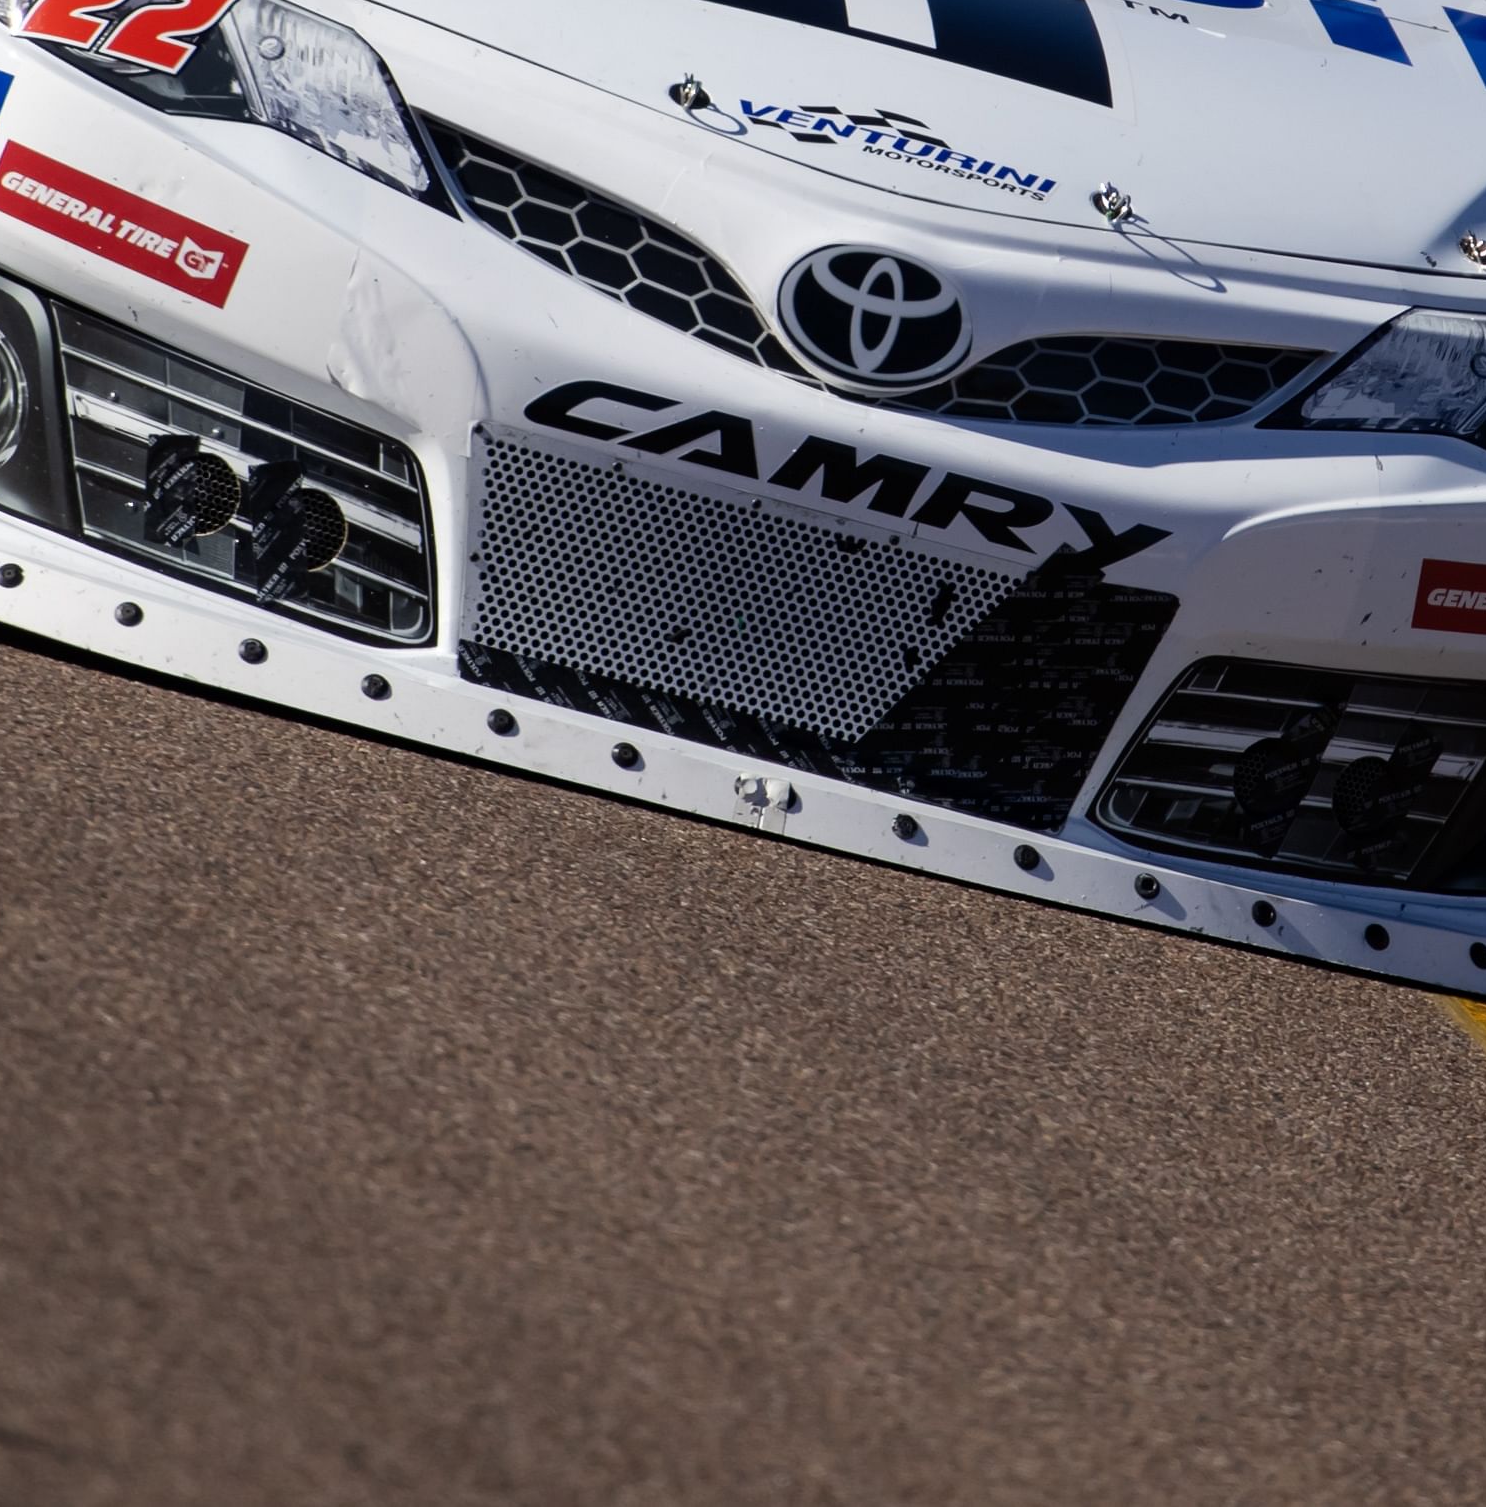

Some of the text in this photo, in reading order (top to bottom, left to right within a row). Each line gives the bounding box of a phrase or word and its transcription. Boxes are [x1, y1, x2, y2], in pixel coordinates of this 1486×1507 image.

[739, 99, 1058, 195] VENTURINI
[861, 144, 1046, 203] MOTORSPORTS
[0, 171, 115, 234] GENERAL
[115, 219, 180, 260] TIRE
[524, 379, 1174, 577] CAMRY
